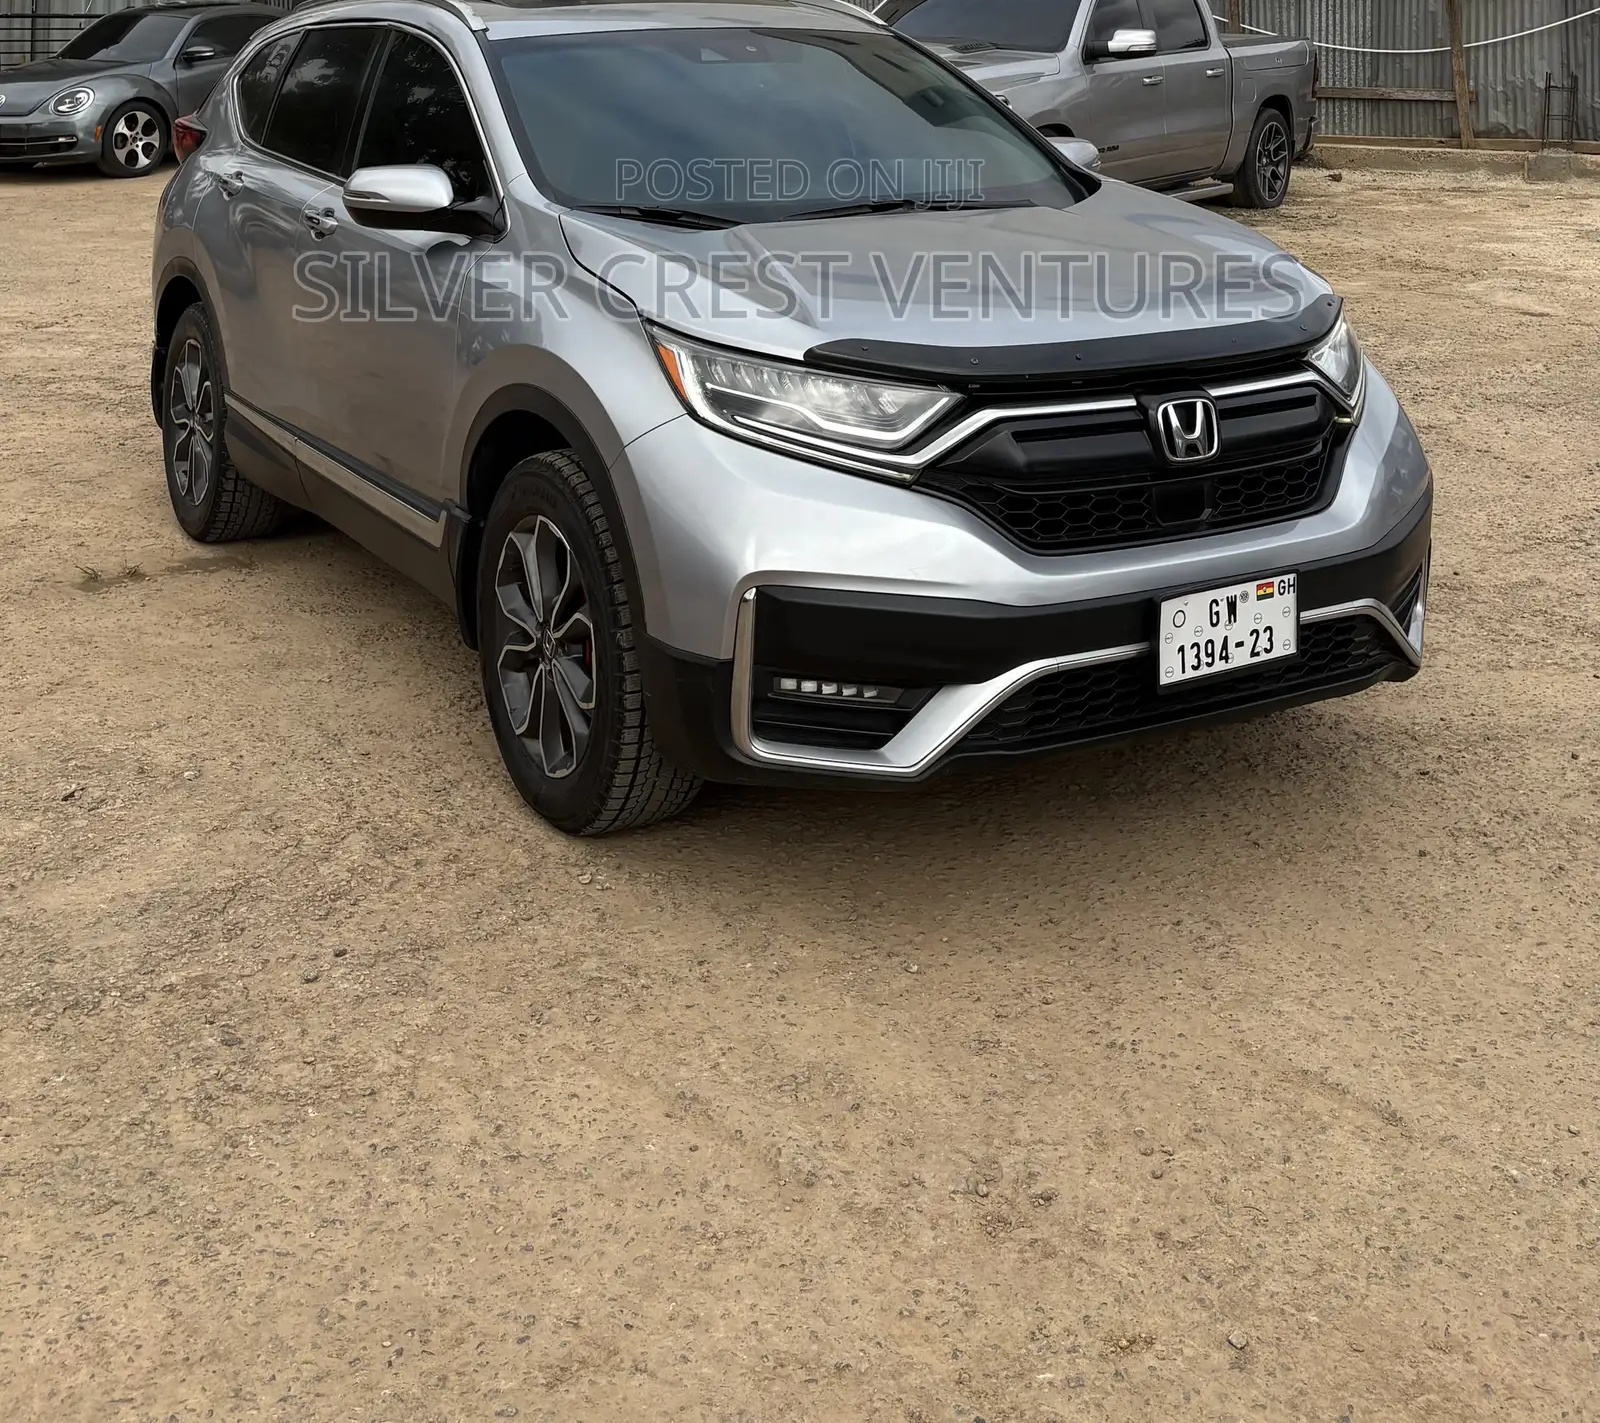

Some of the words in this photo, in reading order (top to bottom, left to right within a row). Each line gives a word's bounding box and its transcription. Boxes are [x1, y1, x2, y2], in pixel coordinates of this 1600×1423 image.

[1277, 576, 1296, 597] GH
[1208, 593, 1238, 628] GW
[1176, 625, 1275, 675] 1394-23
